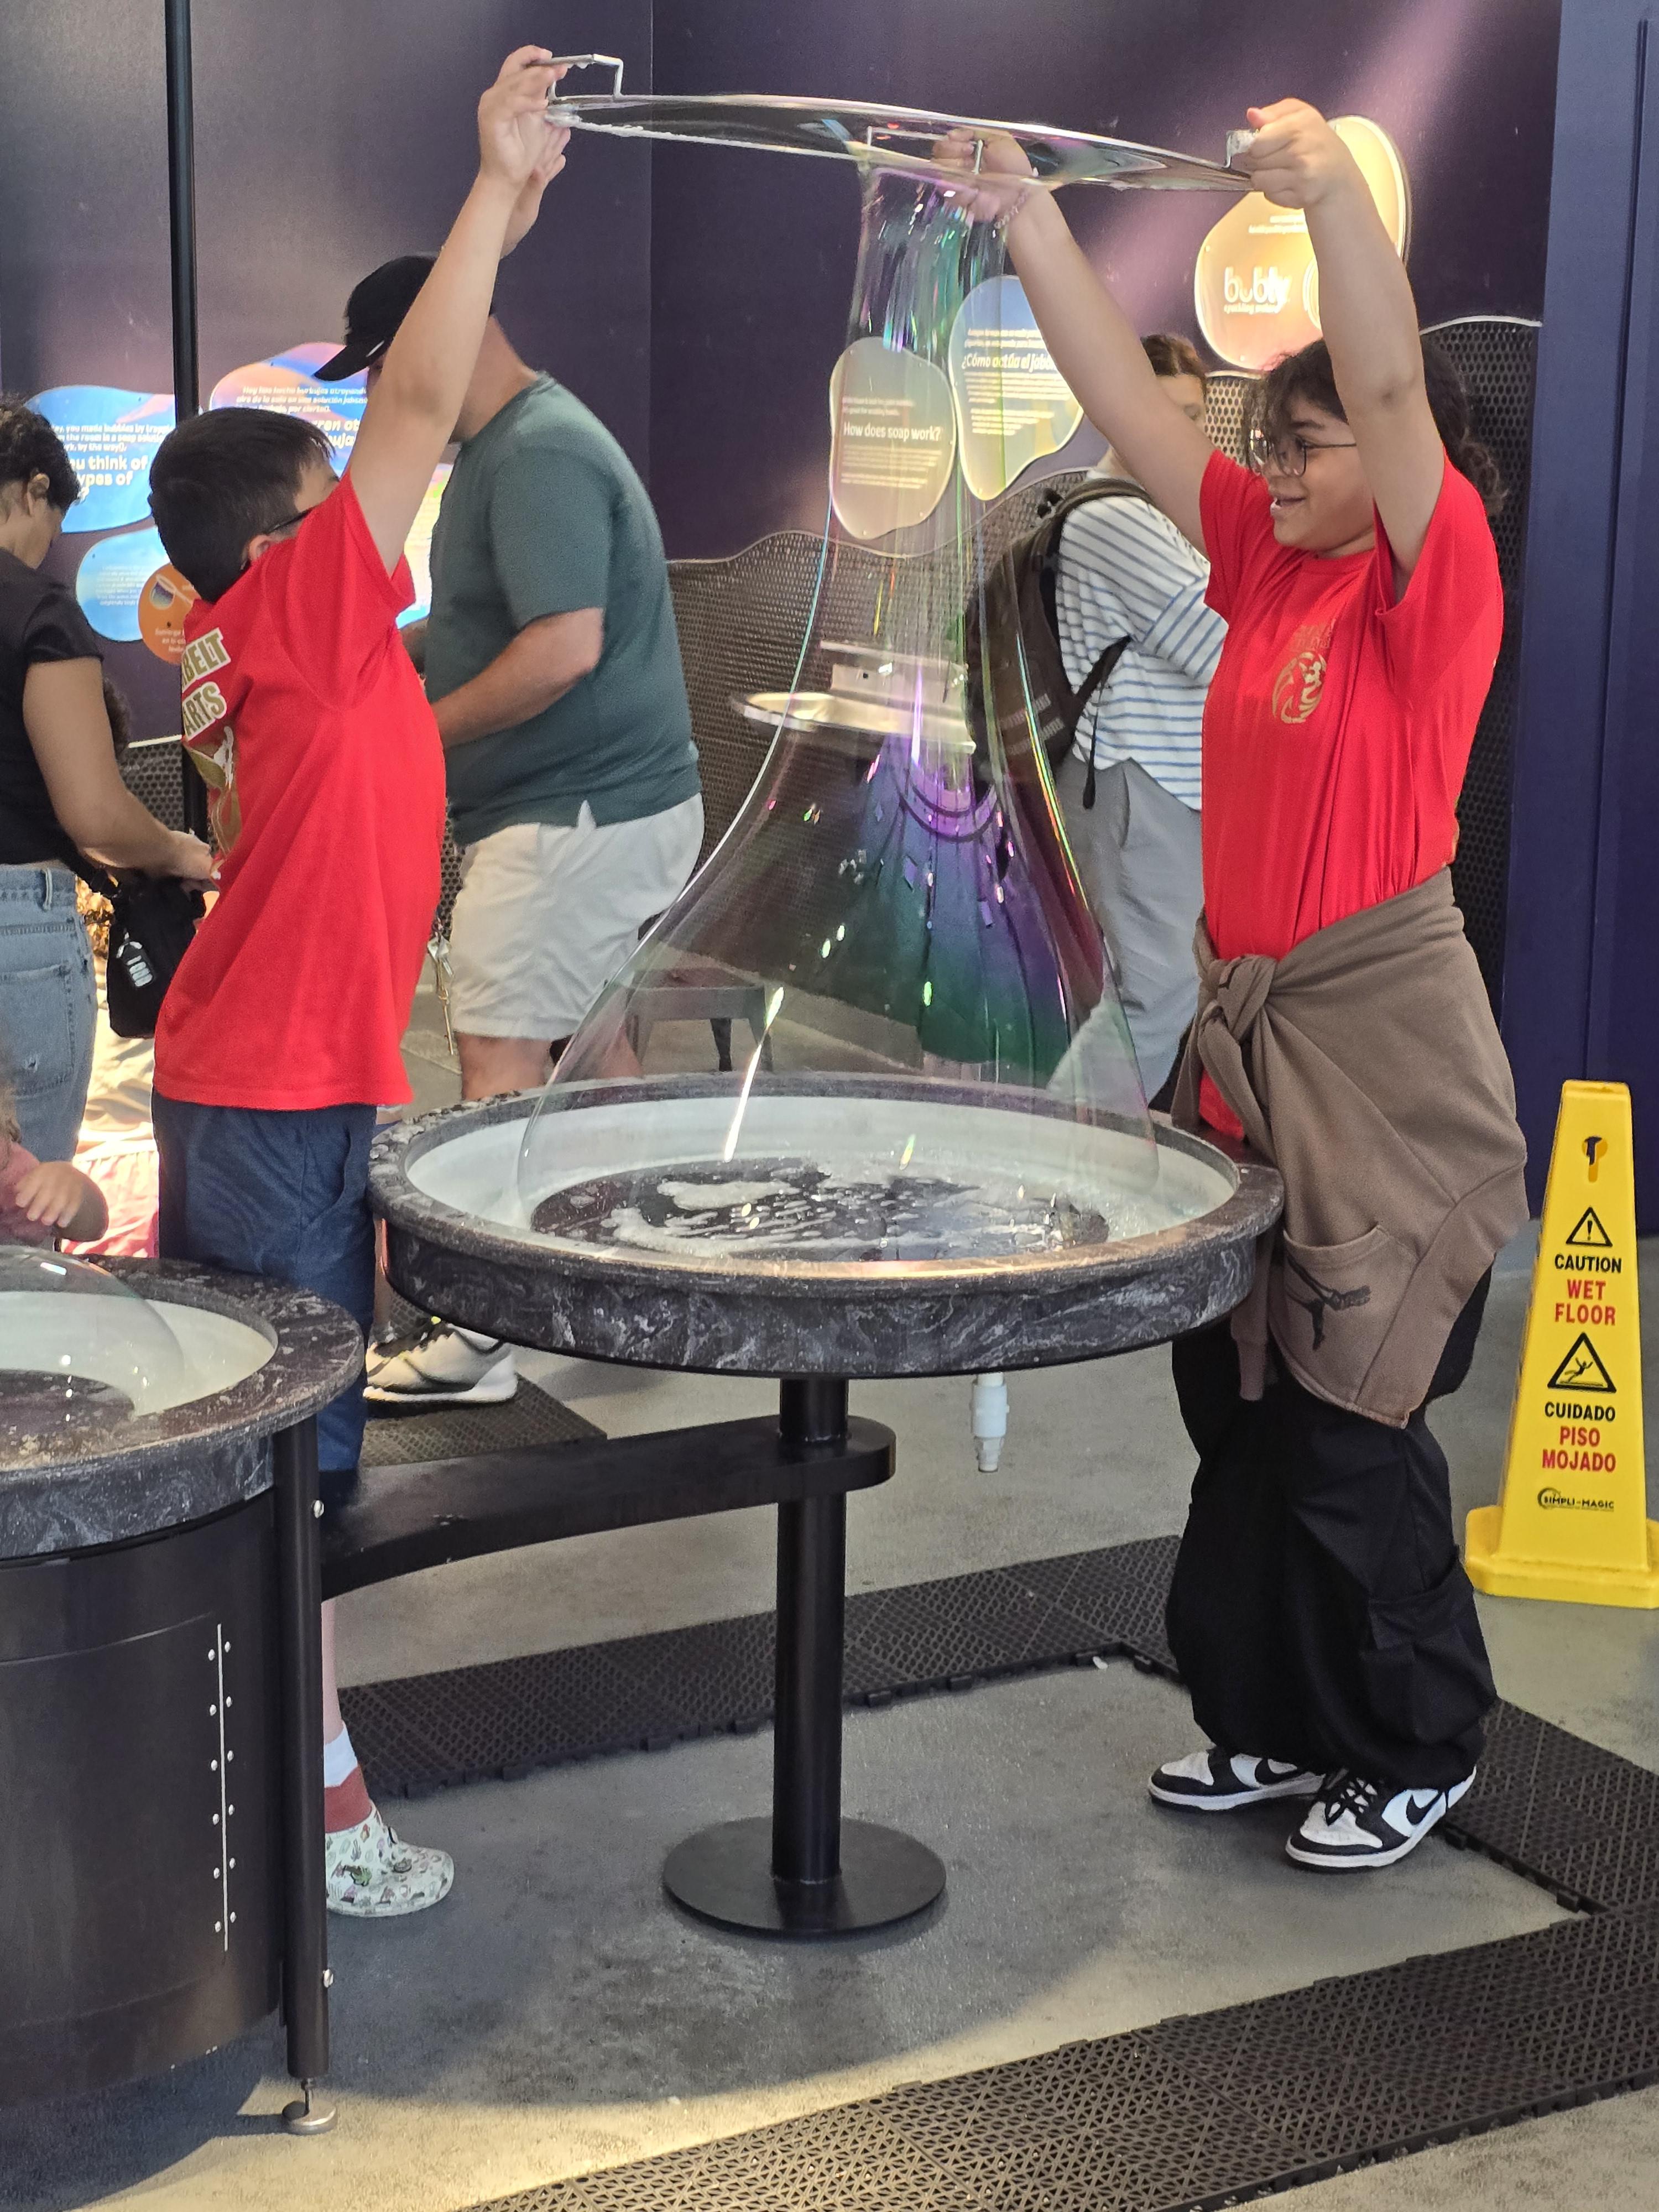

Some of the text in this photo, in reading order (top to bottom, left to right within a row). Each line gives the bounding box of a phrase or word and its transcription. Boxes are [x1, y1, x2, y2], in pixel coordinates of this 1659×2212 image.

[962, 352, 990, 369] ¿Cómo
[843, 421, 941, 442] How does soap work?
[70, 455, 148, 471] ou think of
[77, 471, 133, 487] ypes of
[1554, 1253, 1622, 1273] CAUTION
[1567, 1279, 1606, 1301] WET
[1554, 1303, 1616, 1326] FLOOR
[1545, 1401, 1616, 1422] CUIDADO
[1559, 1426, 1600, 1447] PISO
[1542, 1448, 1616, 1473] MOJADO
